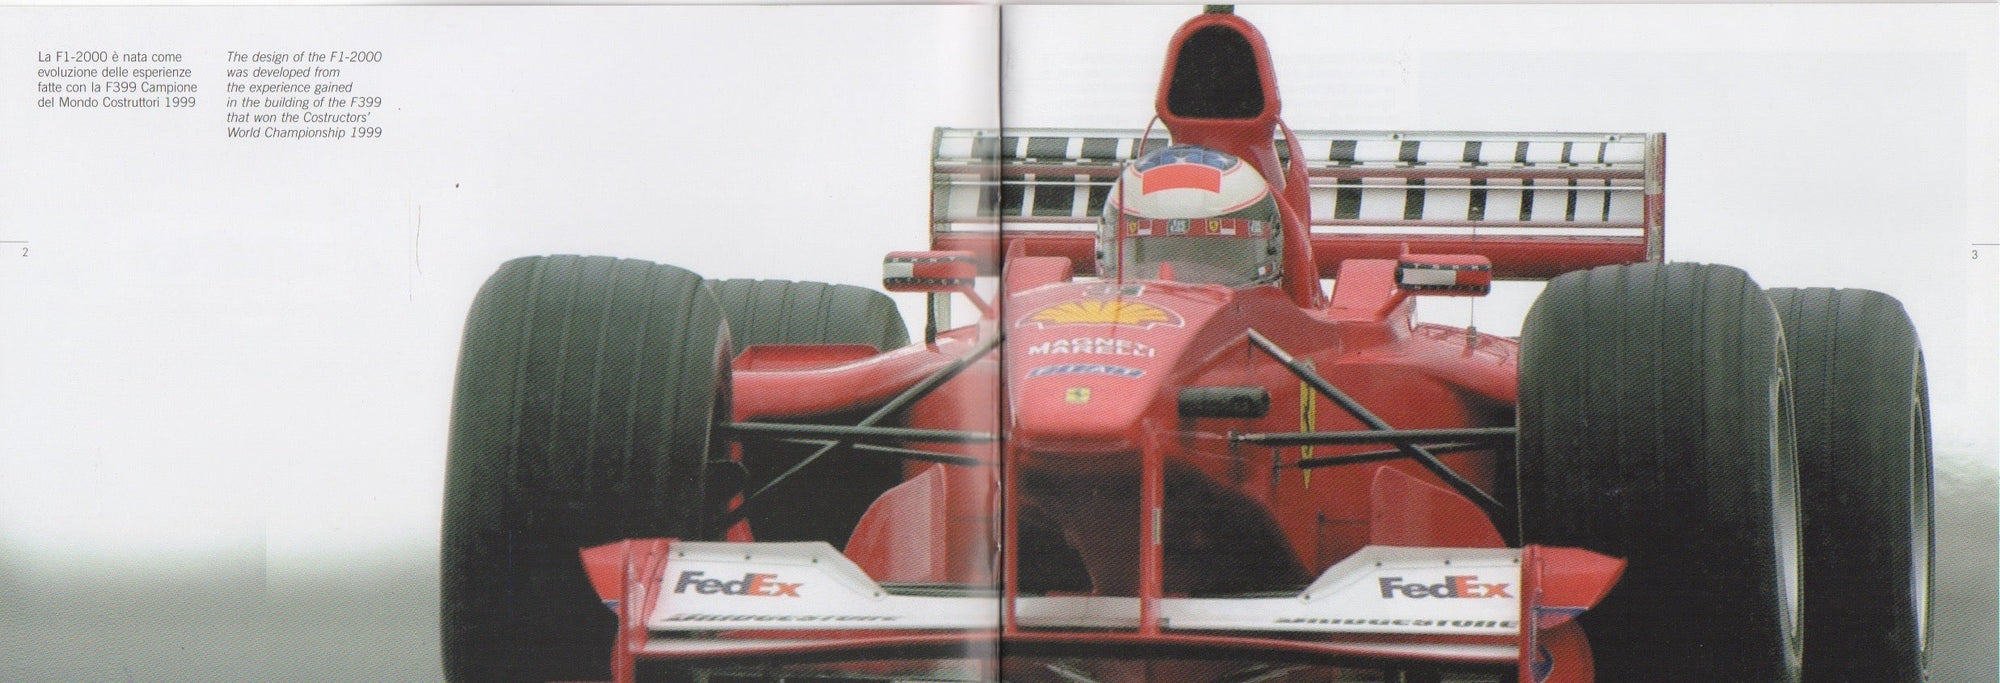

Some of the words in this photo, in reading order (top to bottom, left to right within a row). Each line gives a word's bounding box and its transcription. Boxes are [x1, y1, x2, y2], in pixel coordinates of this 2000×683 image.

[39, 51, 51, 62] La
[57, 51, 107, 62] F1-2000
[112, 51, 118, 62] è
[123, 52, 147, 62] nata
[152, 54, 182, 62] come
[228, 51, 248, 62] The
[252, 51, 288, 64] design
[293, 51, 306, 62] of
[309, 52, 326, 62] the
[330, 51, 382, 62] F1-2000
[38, 66, 97, 77] evoluzione
[102, 66, 128, 77] delle
[133, 67, 191, 80] esperienze
[227, 69, 248, 77] was
[253, 66, 311, 80] developed
[315, 66, 340, 77] from
[38, 82, 62, 92] fatte
[66, 84, 86, 92] con
[92, 81, 100, 92] la
[106, 81, 136, 92] F399
[141, 81, 197, 95] Campione
[227, 82, 245, 93] the
[249, 82, 310, 95] experience
[314, 82, 353, 95] gained
[38, 97, 54, 107] del
[59, 97, 98, 107] Mondo
[103, 97, 159, 107] Costruttori
[165, 97, 195, 107] 1999
[227, 97, 237, 107] in
[242, 97, 260, 107] the
[265, 97, 309, 110] building
[313, 97, 325, 107] of
[328, 97, 346, 107] the
[351, 97, 381, 107] F399
[227, 112, 249, 122] that
[254, 114, 276, 122] won
[282, 112, 299, 122] the
[228, 127, 261, 138] World
[265, 127, 345, 141] Championship
[350, 127, 382, 138] 1999
[22, 247, 29, 258] 2
[1971, 249, 1979, 260] 3
[674, 571, 804, 598] FedEx
[1379, 575, 1514, 599] FedEx
